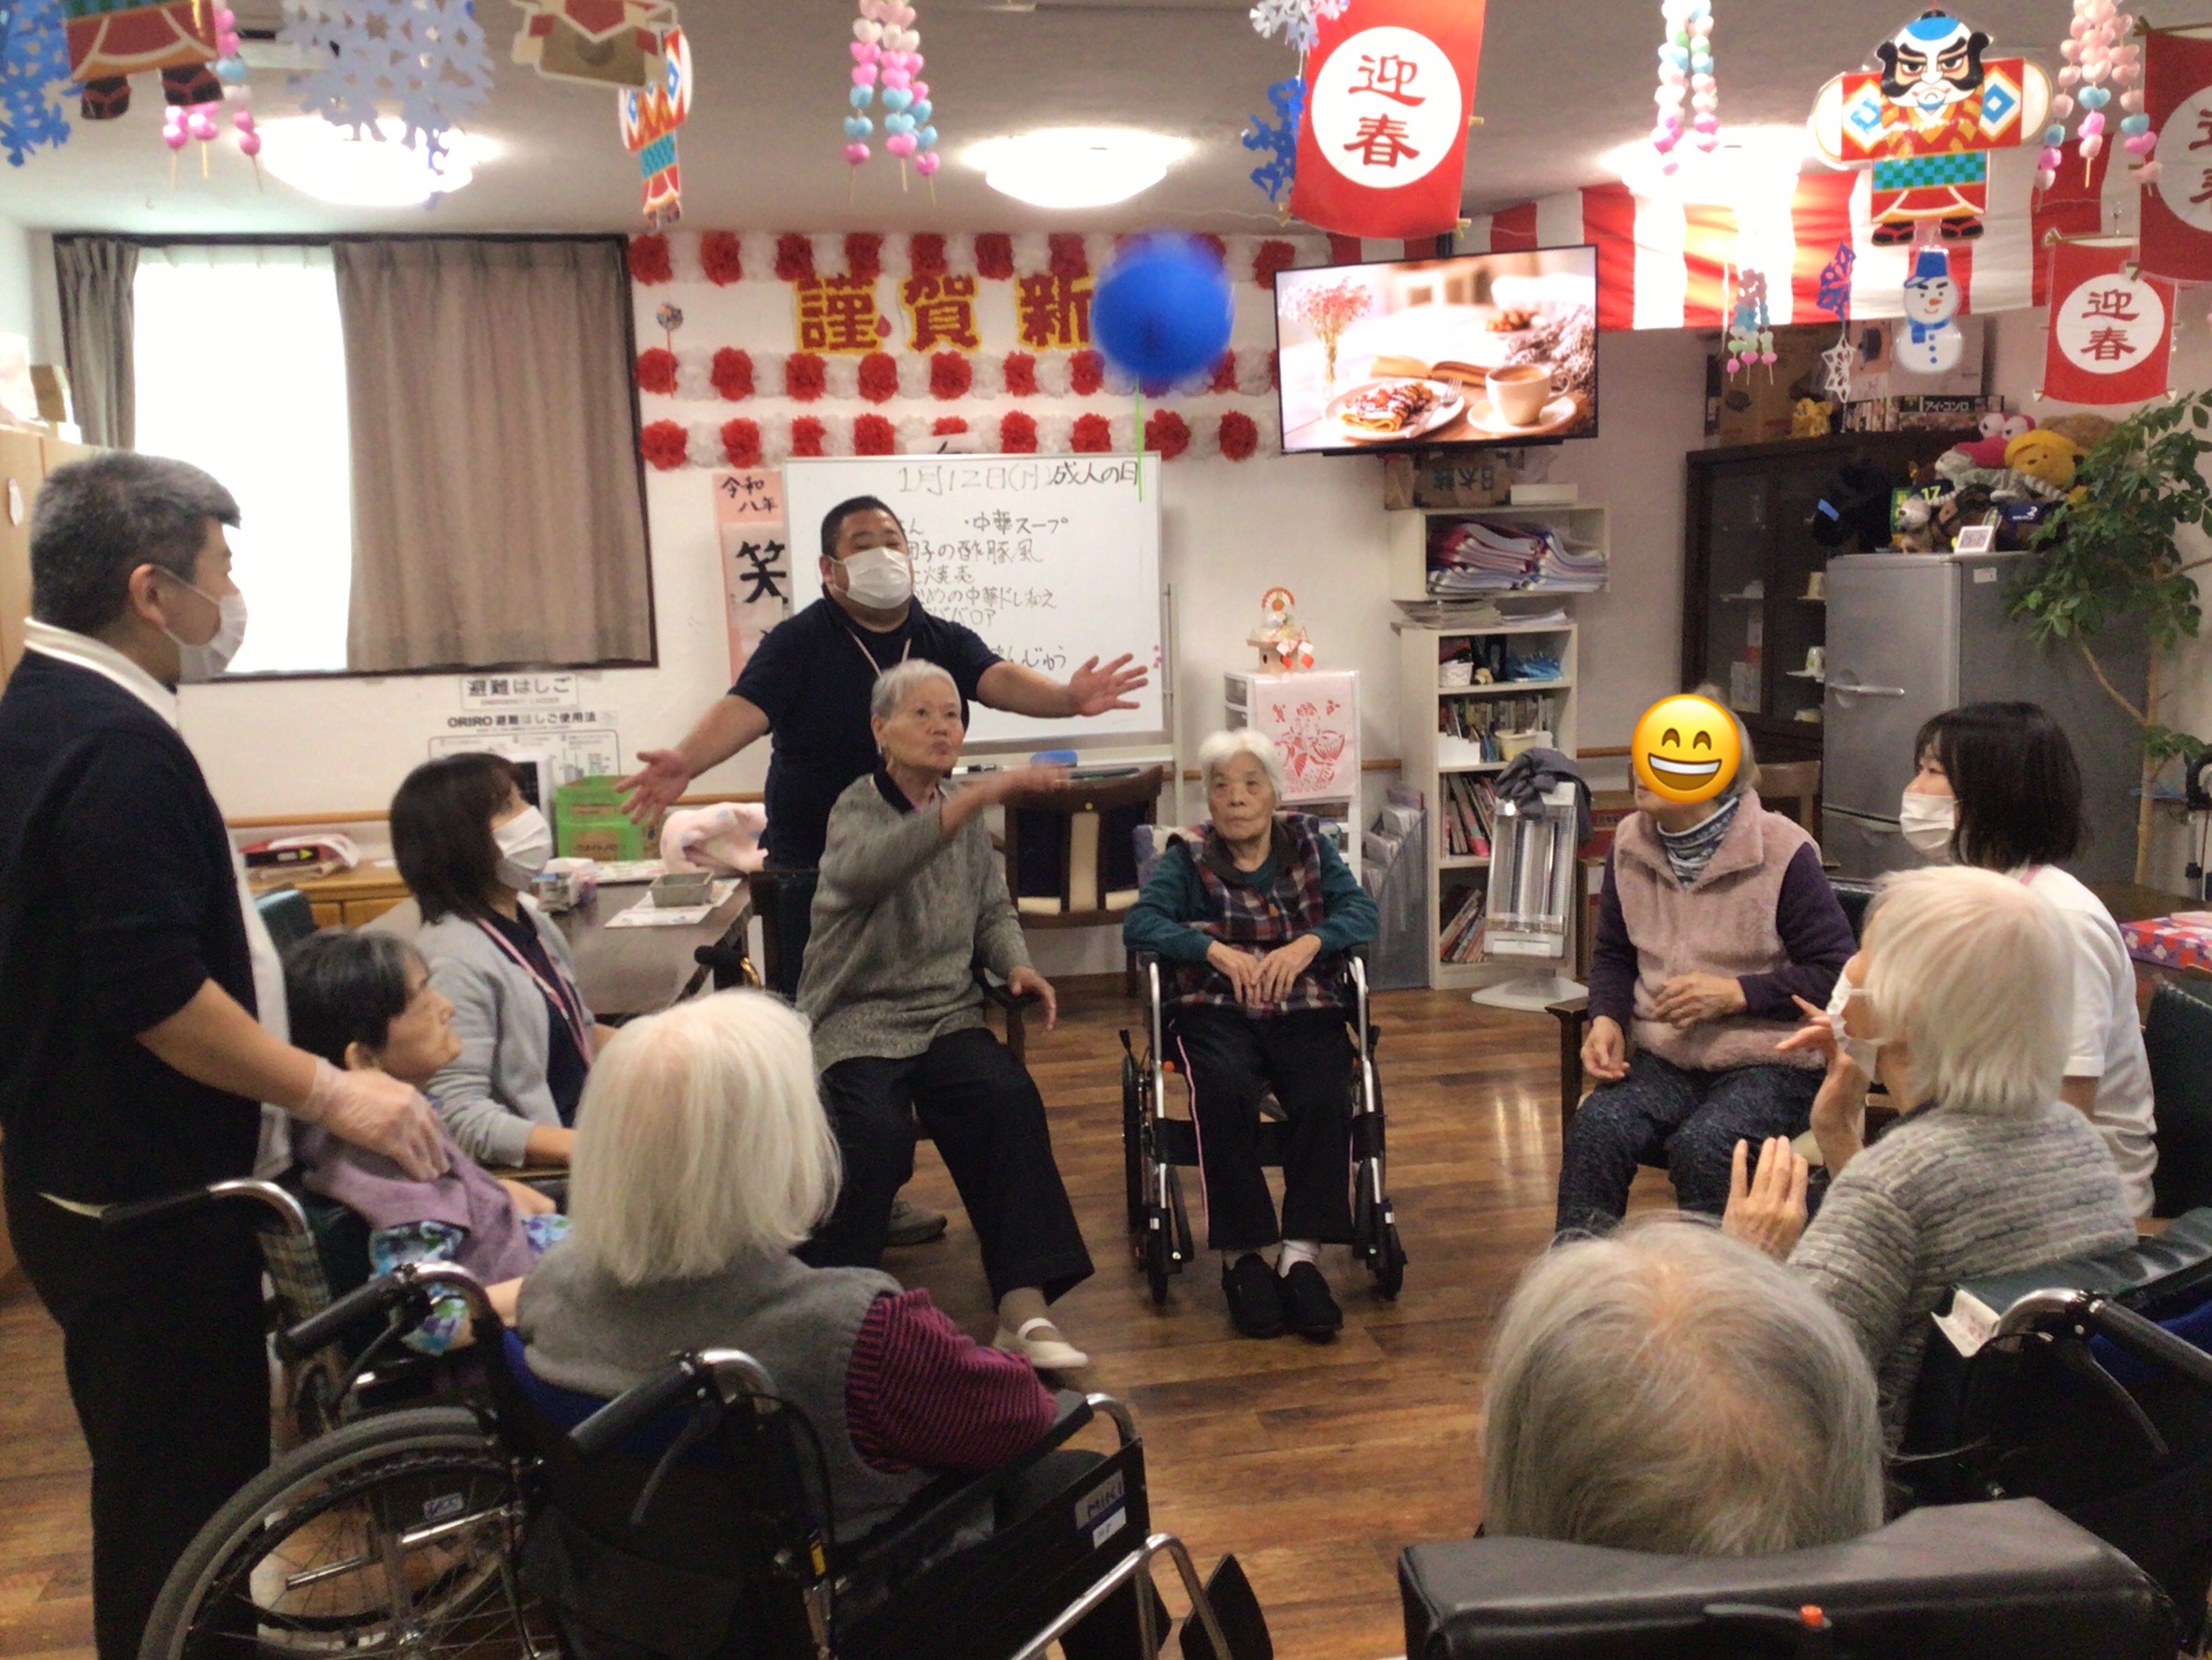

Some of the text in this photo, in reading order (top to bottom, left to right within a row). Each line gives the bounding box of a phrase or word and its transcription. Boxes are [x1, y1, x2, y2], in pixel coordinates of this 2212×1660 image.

[1344, 54, 1426, 167] 迎春
[2080, 288, 2139, 360] 迎春
[721, 475, 764, 499] 令和
[736, 539, 789, 604] 笑
[468, 677, 571, 697] 避難はしご
[447, 716, 493, 729] ORIRO
